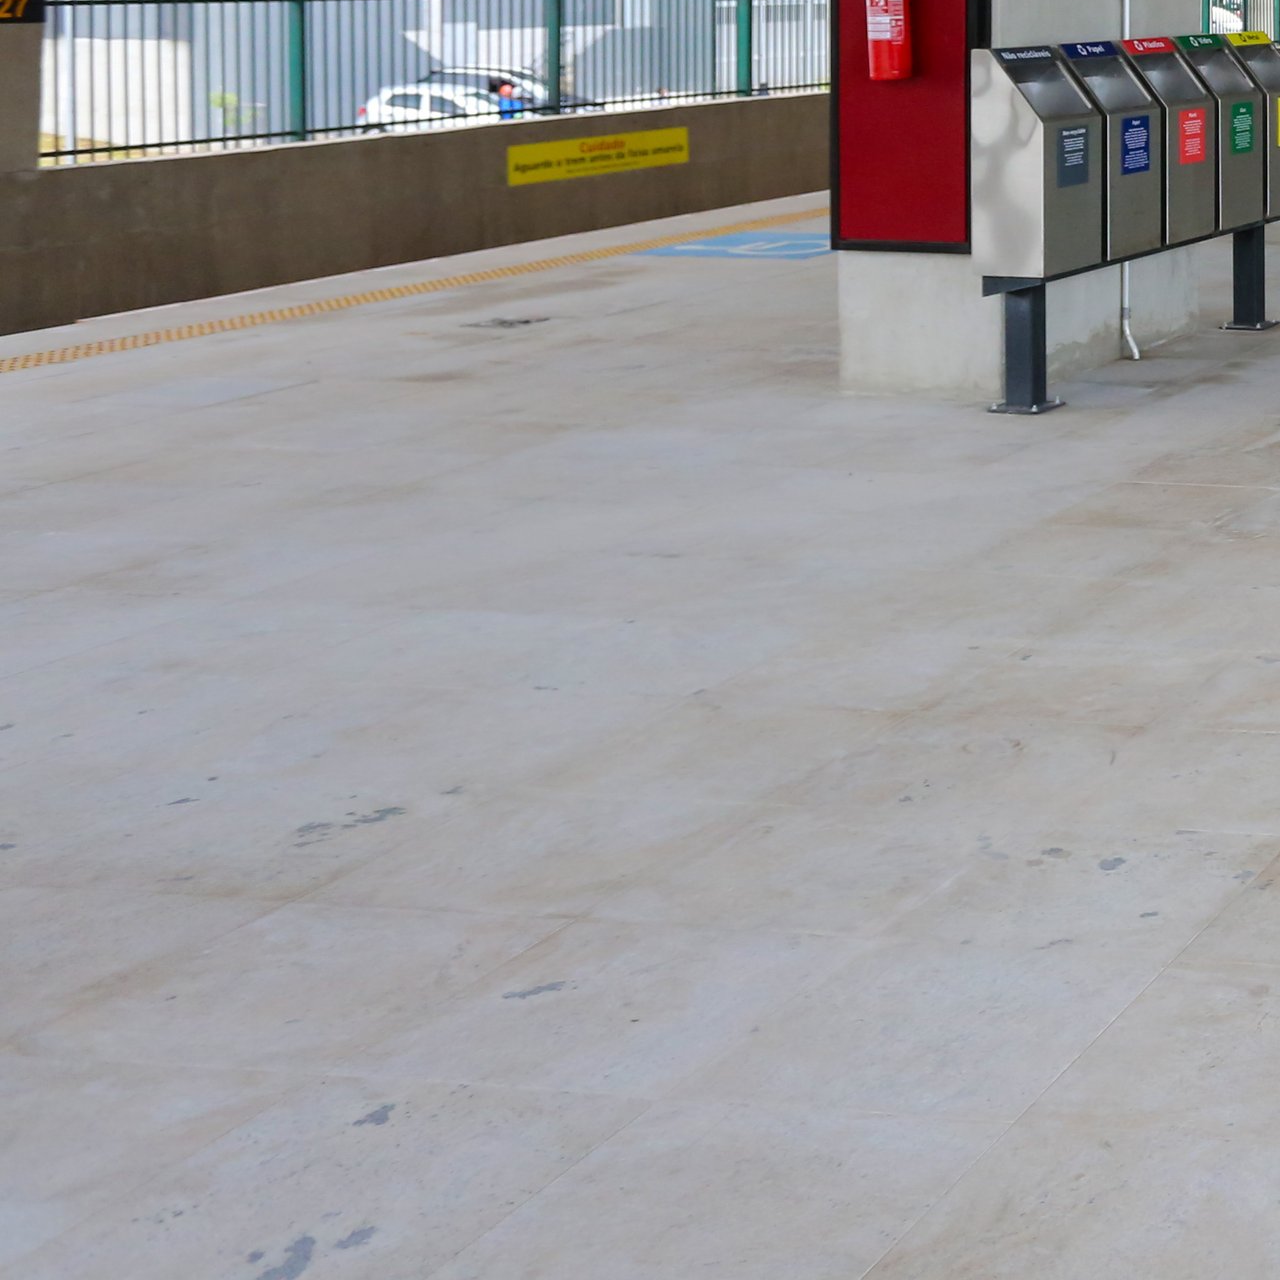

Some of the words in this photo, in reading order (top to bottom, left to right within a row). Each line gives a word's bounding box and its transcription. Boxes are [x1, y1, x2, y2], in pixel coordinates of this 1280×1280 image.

[1001, 52, 1016, 60] Não
[1017, 48, 1051, 59] recicláveis
[1087, 44, 1105, 53] Papel
[579, 139, 626, 153] Cuidado
